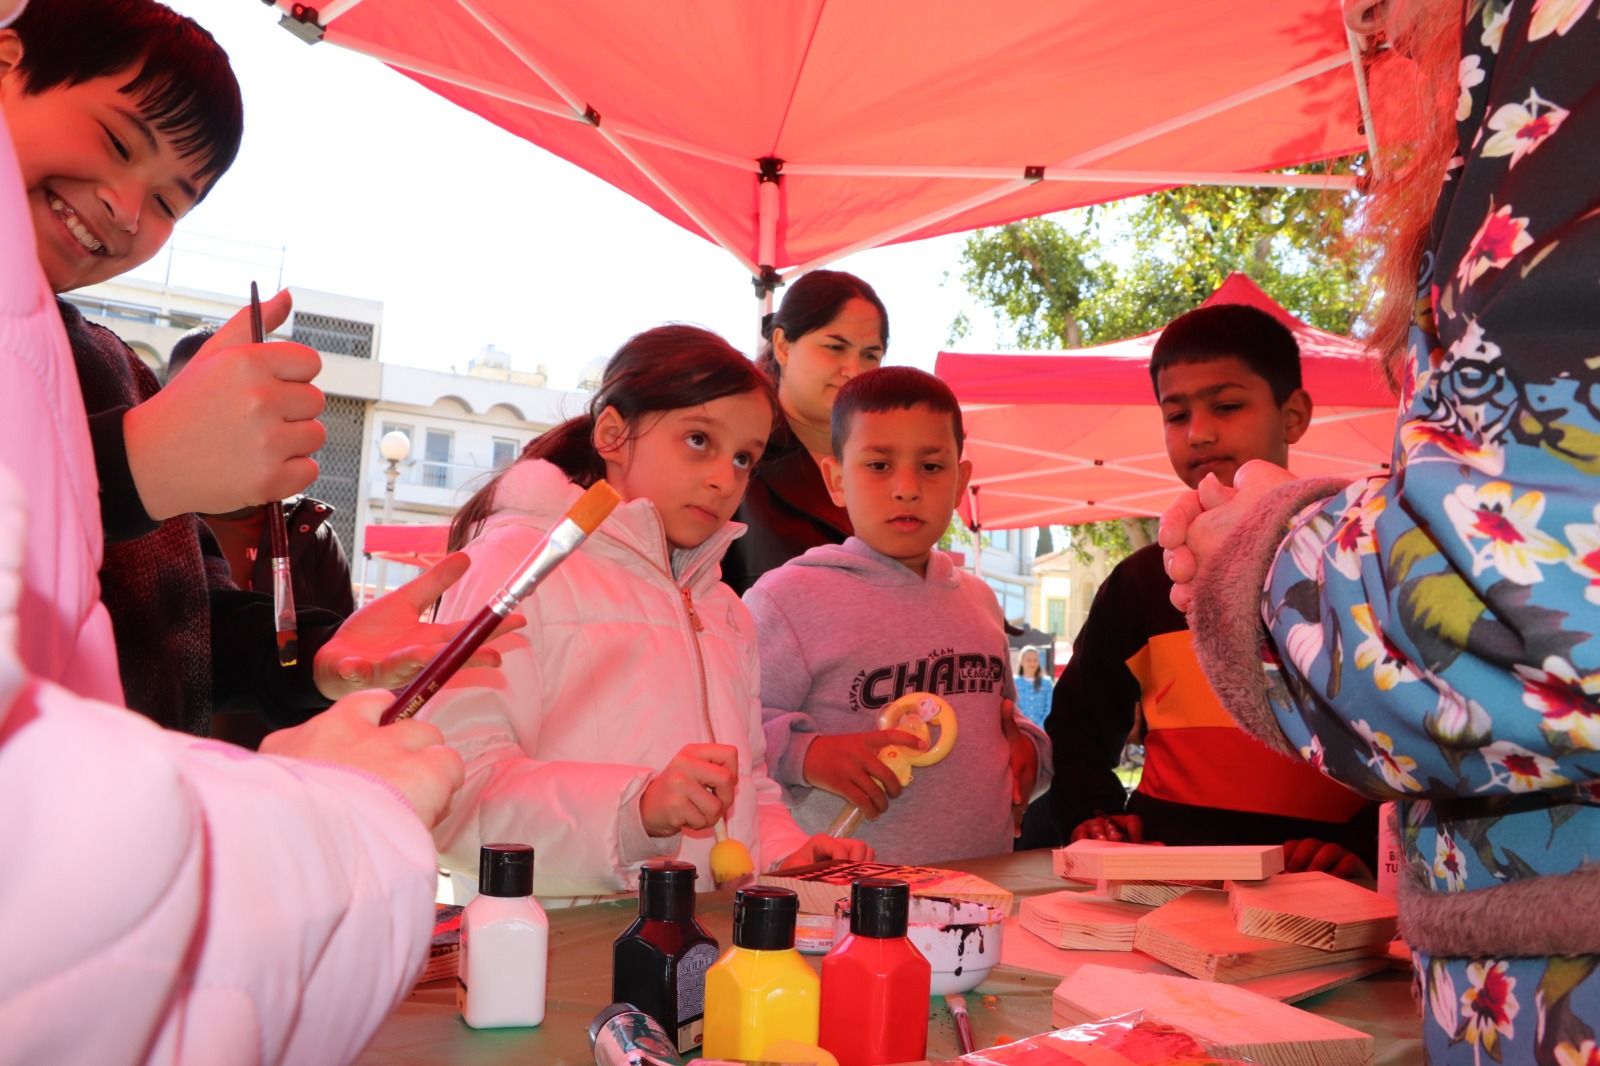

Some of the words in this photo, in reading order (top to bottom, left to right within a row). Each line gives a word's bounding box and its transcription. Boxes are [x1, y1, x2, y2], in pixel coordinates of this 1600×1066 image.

[928, 648, 954, 660] TEAM
[860, 653, 1005, 709] CHAMP
[960, 668, 998, 680] LEAGUE
[849, 669, 867, 712] ALWAYS
